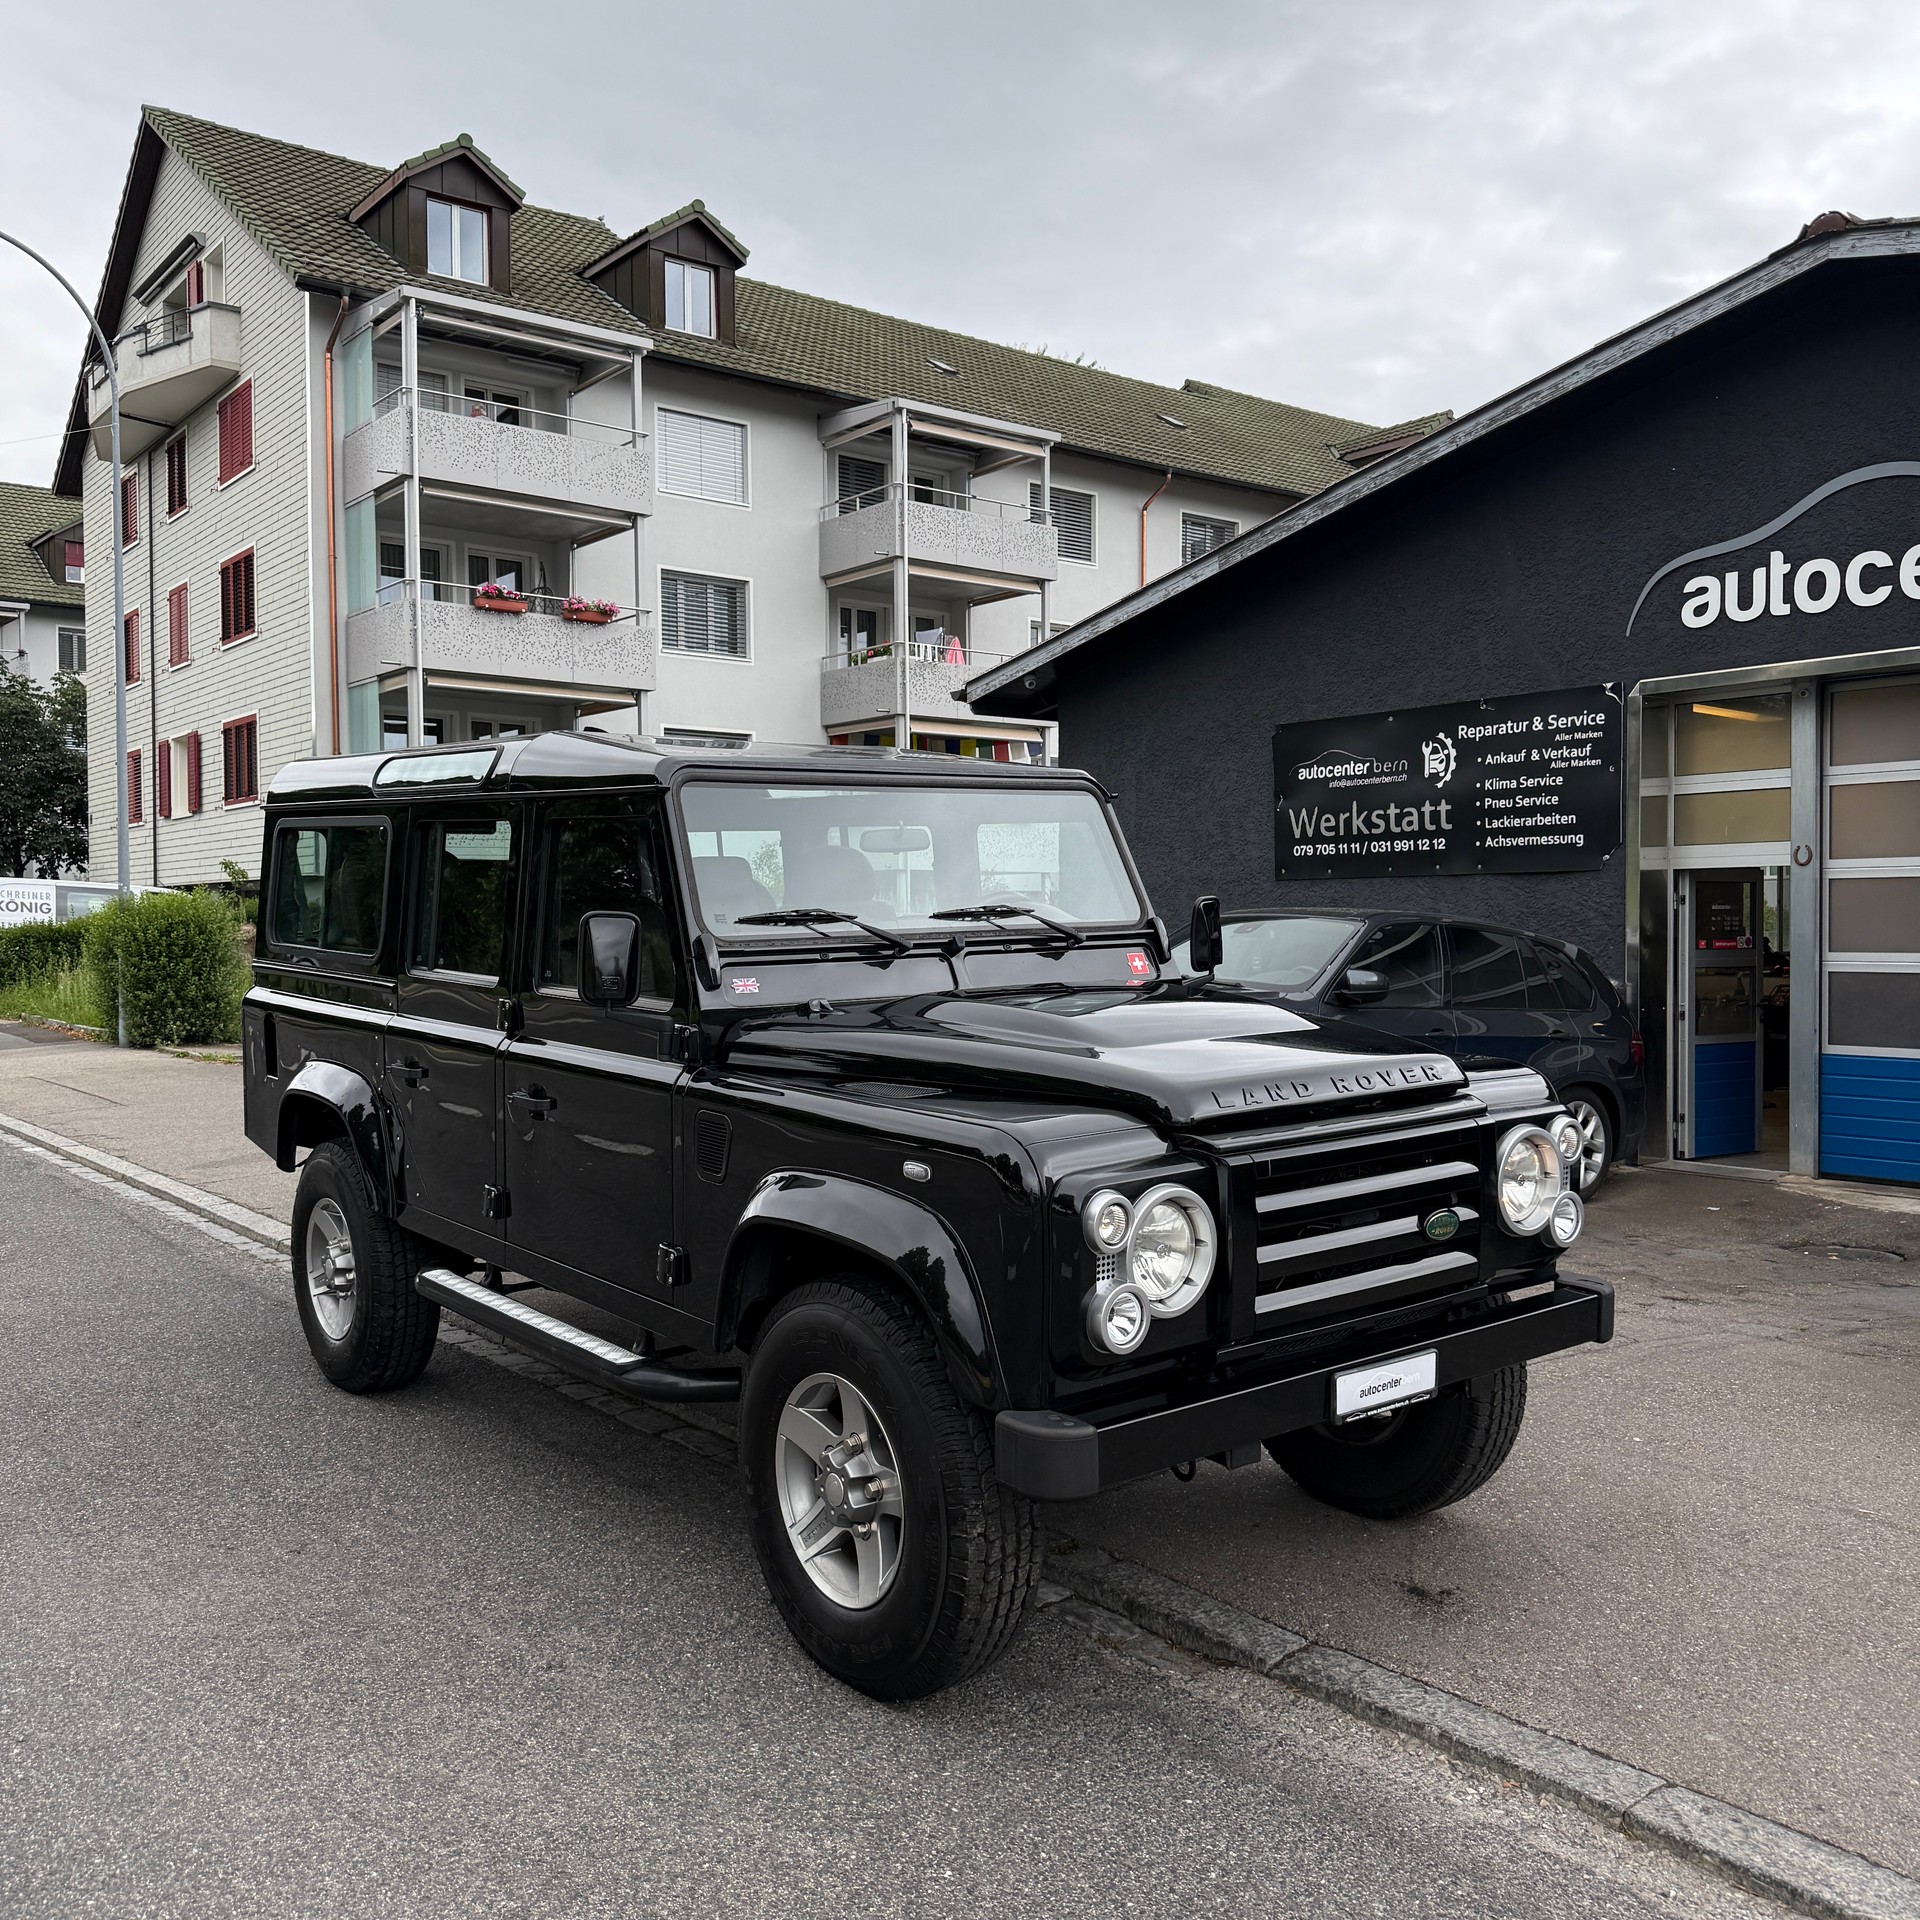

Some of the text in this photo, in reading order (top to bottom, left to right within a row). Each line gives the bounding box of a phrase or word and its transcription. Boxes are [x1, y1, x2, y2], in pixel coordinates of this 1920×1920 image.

[1458, 710, 1605, 741] Reparatur & Service
[1554, 731, 1603, 742] Aller Marken
[1485, 743, 1592, 765] Ankauf & Verkauf
[1298, 758, 1408, 780] autocenter bern
[1550, 758, 1602, 769] Aller Marken
[1328, 773, 1408, 788] info@autocenterbern.ch
[1484, 774, 1564, 791] Klima Service
[1484, 793, 1559, 809] Pneu Service
[1288, 799, 1453, 839] Werkstatt
[1485, 812, 1577, 829] Lackierarbeiten
[1293, 838, 1446, 856] 079 705 11 11 / 031 991 12 12
[1485, 833, 1584, 848] Achsvermessung
[1211, 1064, 1443, 1109] LAND ROVER
[1359, 1377, 1402, 1399] autocenter
